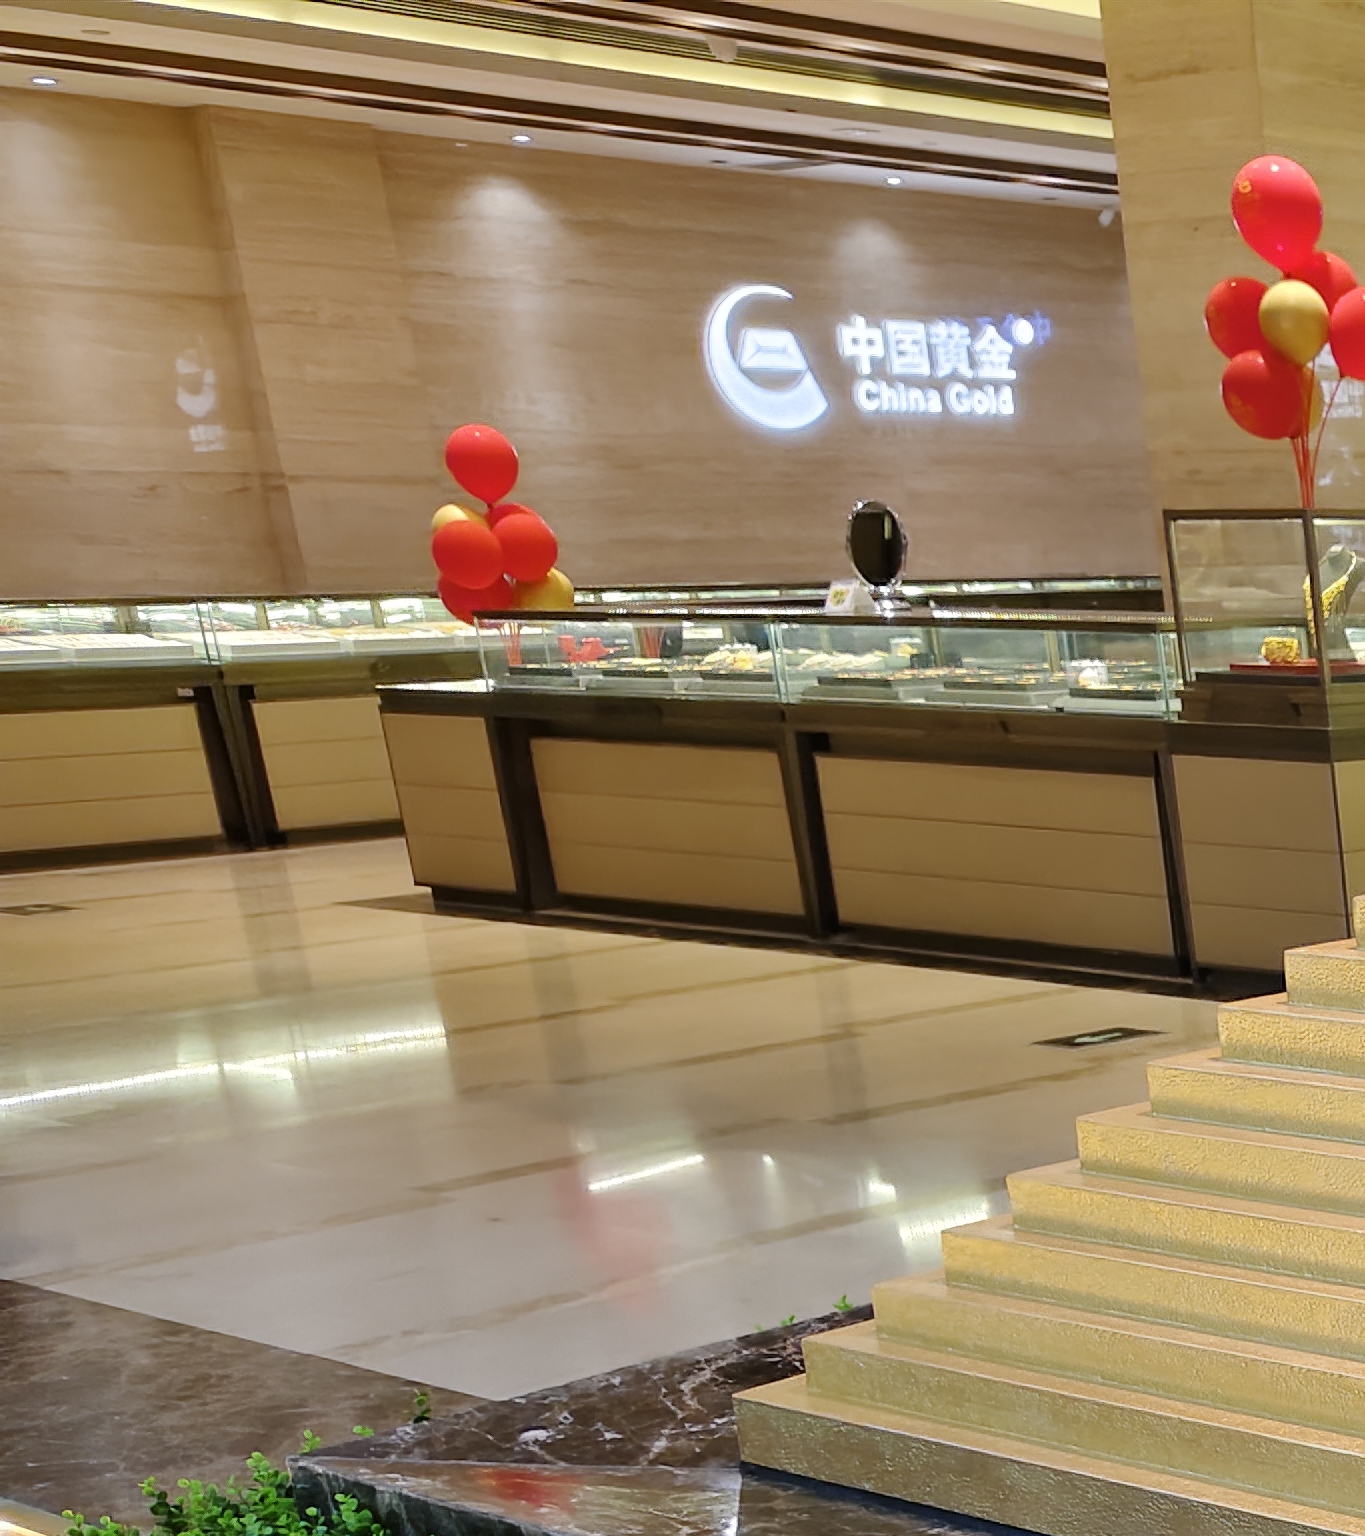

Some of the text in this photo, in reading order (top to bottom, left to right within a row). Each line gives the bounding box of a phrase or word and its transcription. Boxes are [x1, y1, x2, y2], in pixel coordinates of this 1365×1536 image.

[840, 315, 1016, 379] 中国黄金
[856, 379, 1014, 415] China Gold
